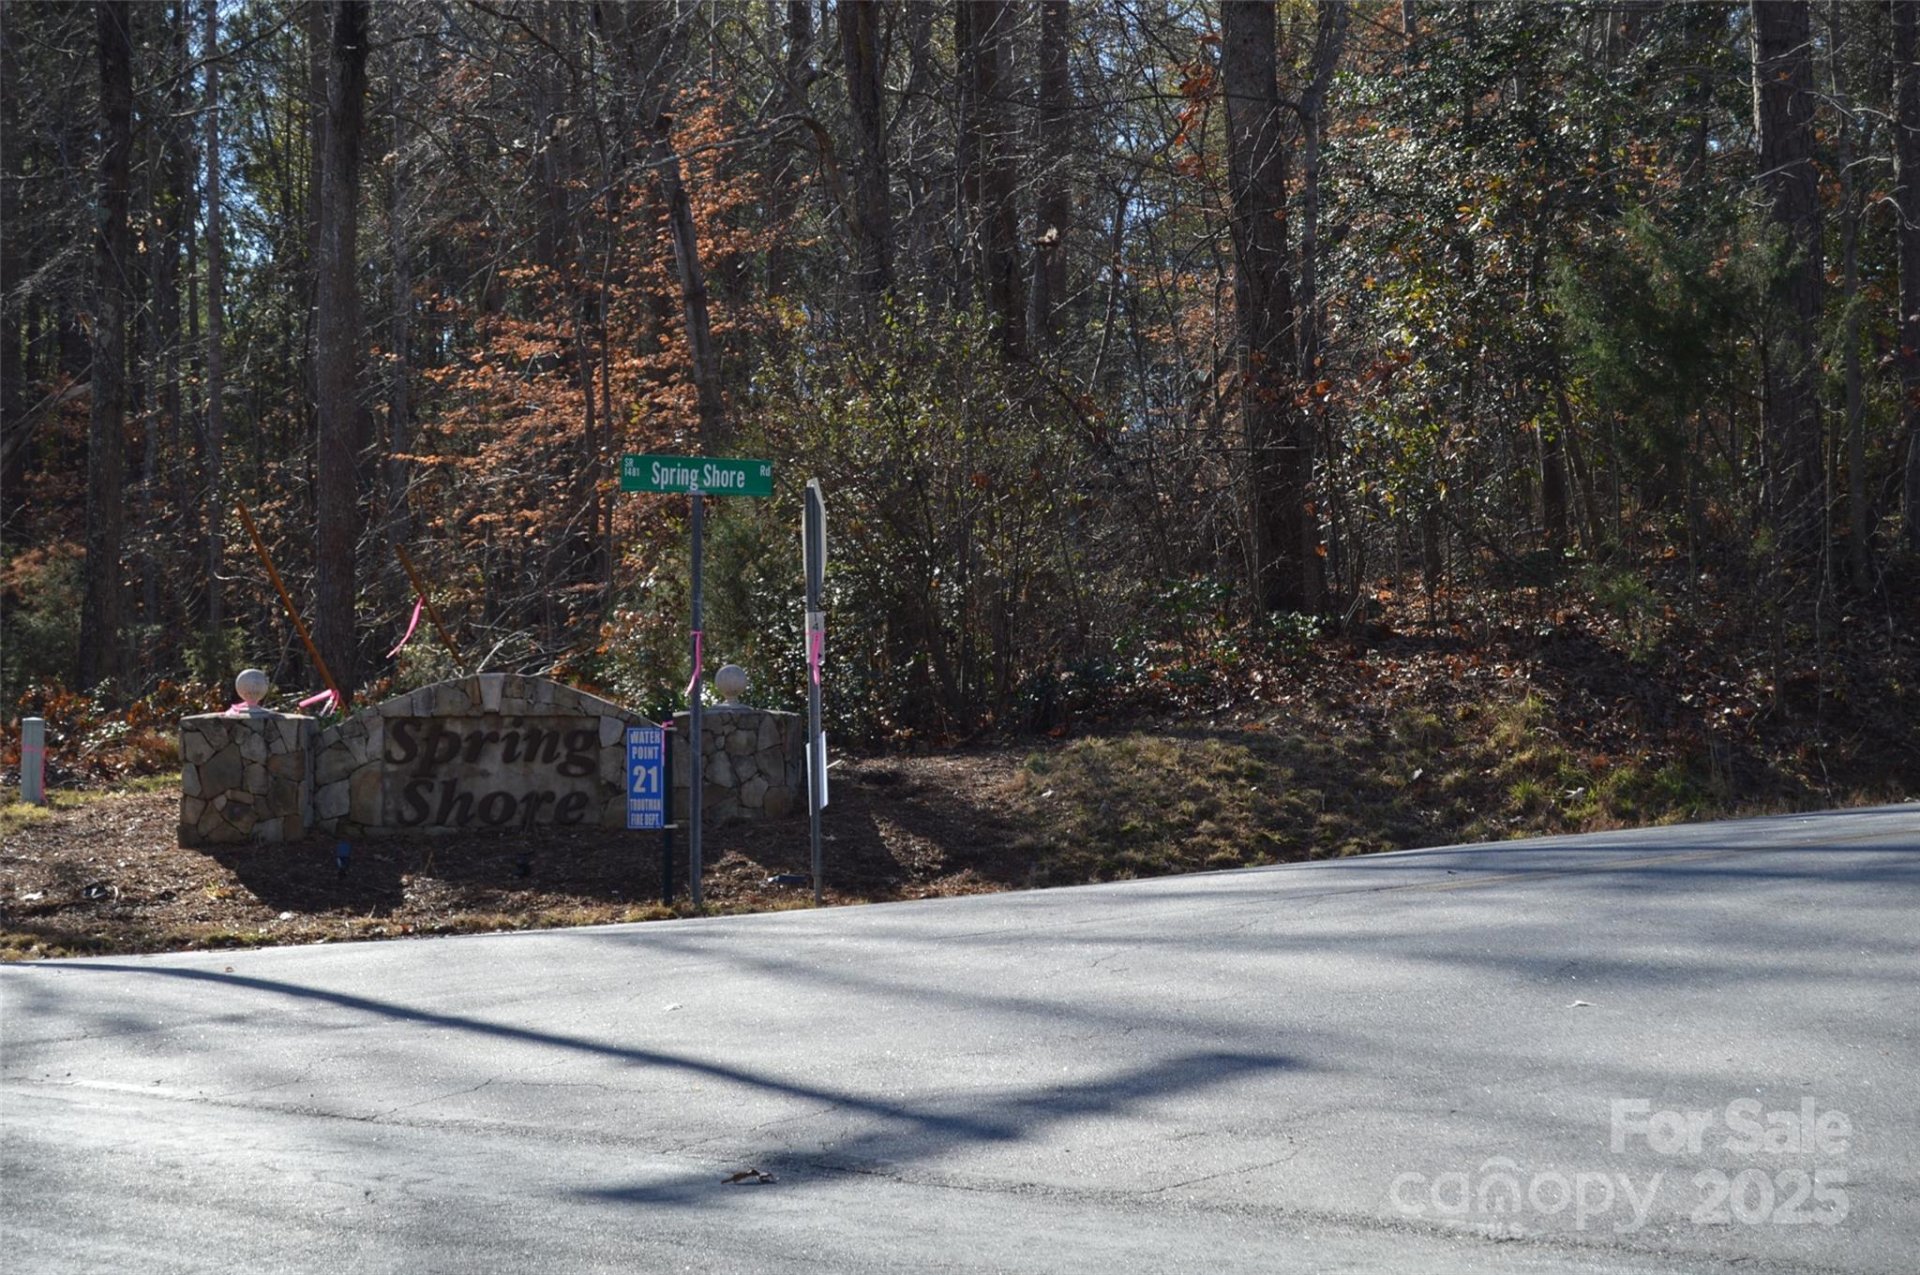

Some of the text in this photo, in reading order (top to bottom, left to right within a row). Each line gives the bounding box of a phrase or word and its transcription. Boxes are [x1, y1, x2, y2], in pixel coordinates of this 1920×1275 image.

[624, 457, 634, 467] SR
[651, 461, 771, 490] Spring Shore Rd
[630, 730, 661, 744] WATER
[384, 718, 600, 778] Spring
[632, 746, 659, 760] POINT
[633, 765, 658, 793] 21
[396, 777, 590, 826] Shore
[629, 799, 661, 812] TROUTMAN
[631, 813, 644, 826] FIRE
